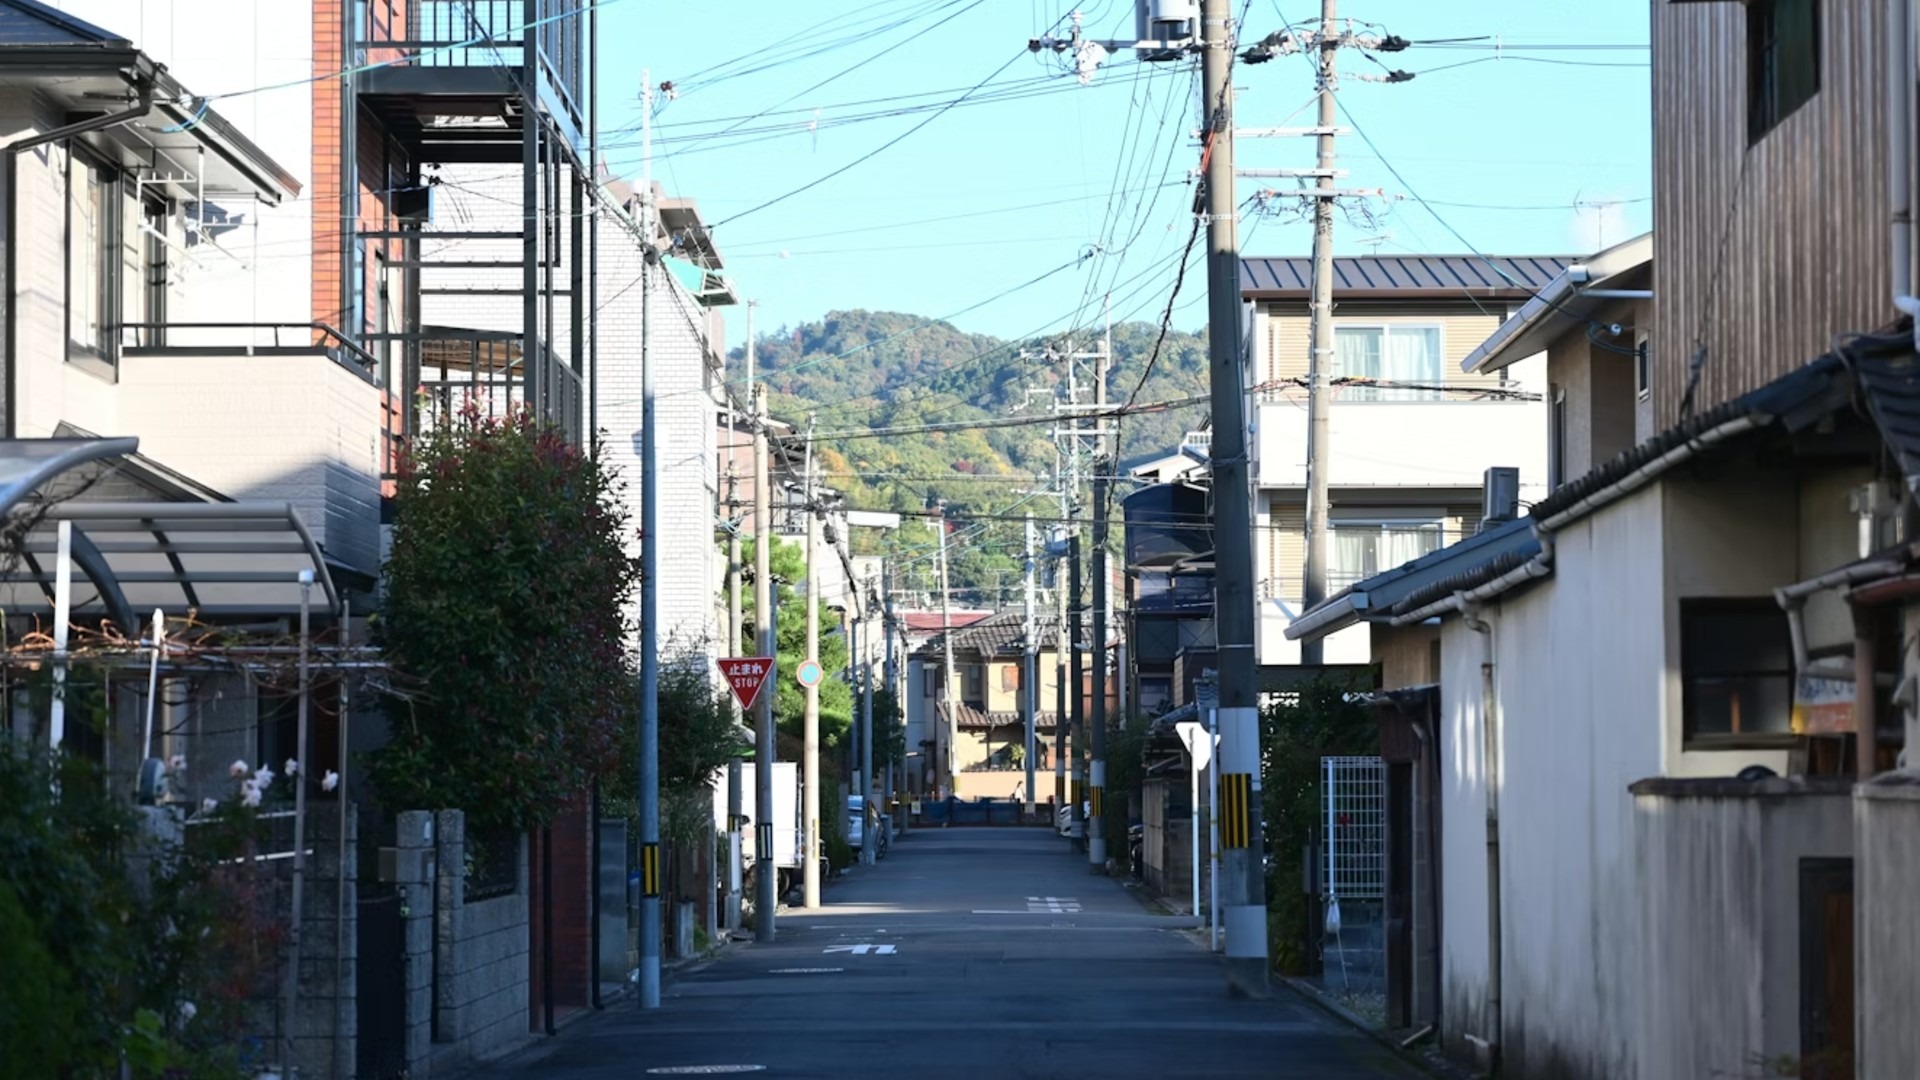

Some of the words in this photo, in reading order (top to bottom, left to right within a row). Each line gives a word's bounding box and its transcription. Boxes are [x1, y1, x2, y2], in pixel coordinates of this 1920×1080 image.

[728, 663, 764, 676] 止まれ
[735, 677, 759, 688] STOP
